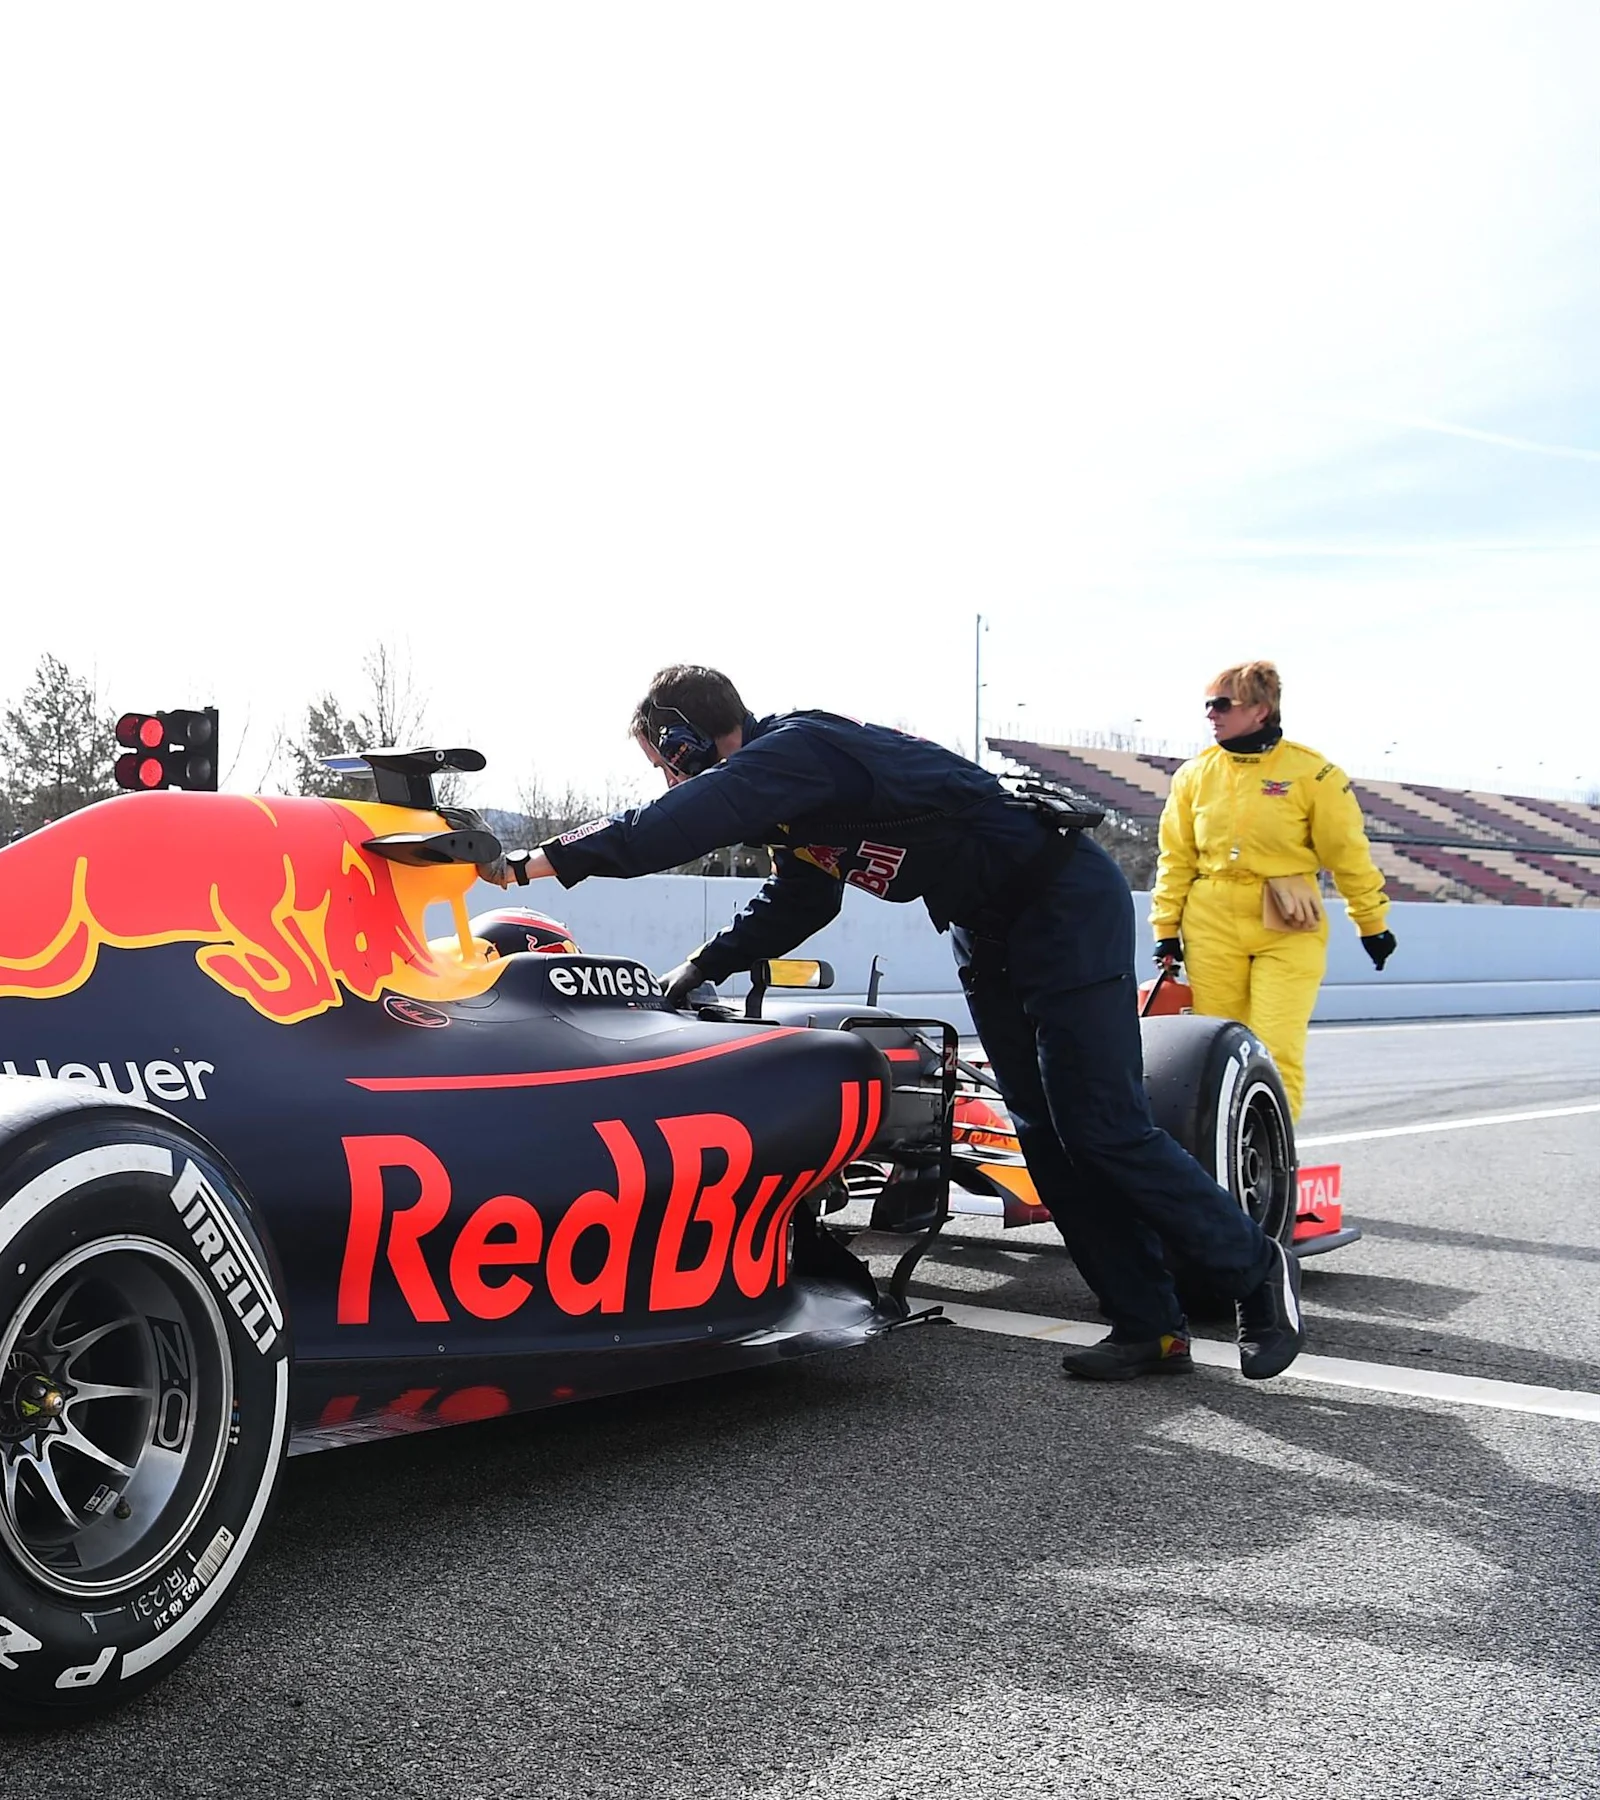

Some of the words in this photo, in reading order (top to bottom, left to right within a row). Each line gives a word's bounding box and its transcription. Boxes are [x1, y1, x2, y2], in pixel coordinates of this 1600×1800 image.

[845, 840, 908, 898] Bull
[548, 966, 663, 997] exness
[337, 1113, 647, 1325] Red
[649, 1079, 881, 1313] Bull
[169, 1157, 284, 1355] PIRELLI
[219, 1531, 229, 1542] R
[55, 1646, 118, 1689] P
